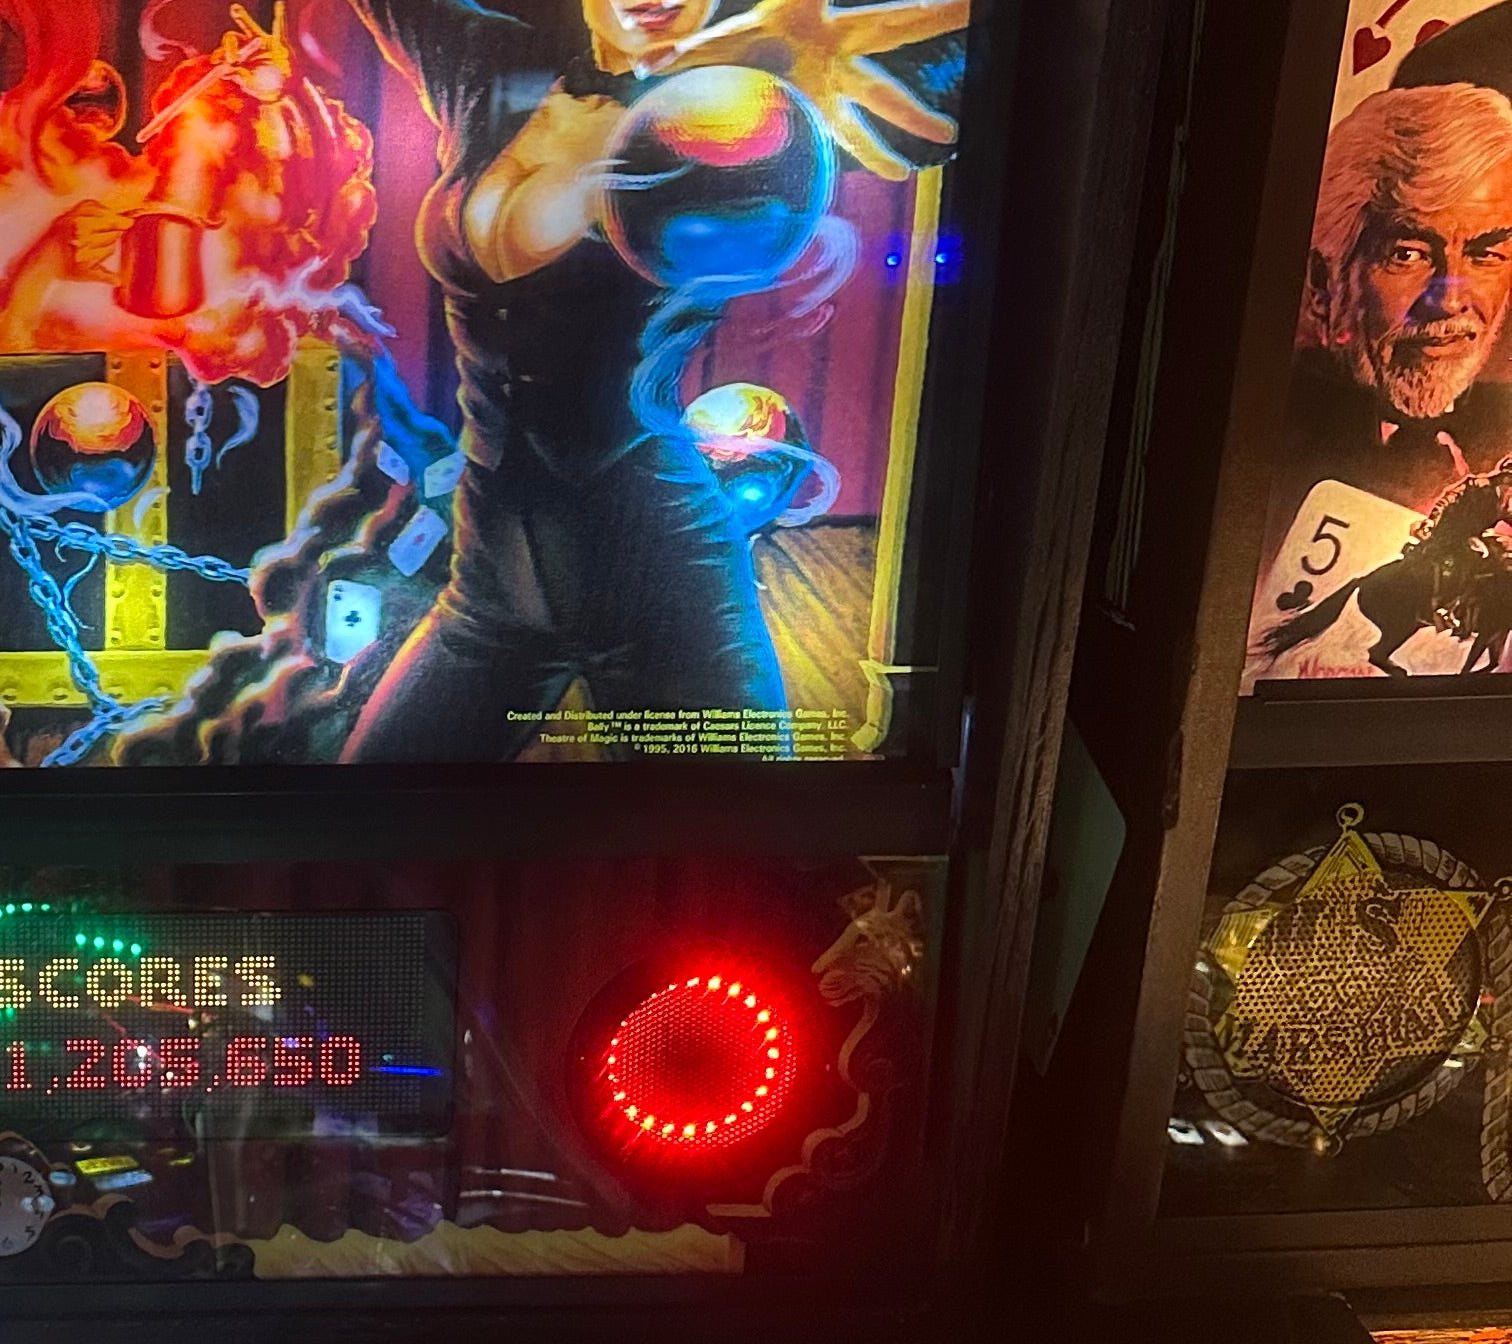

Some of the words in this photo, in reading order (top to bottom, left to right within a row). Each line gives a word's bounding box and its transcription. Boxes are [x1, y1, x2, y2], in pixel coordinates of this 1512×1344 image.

[1301, 514, 1351, 576] 5
[507, 711, 542, 721] Created
[545, 711, 562, 720] and
[564, 710, 614, 720] Distributed
[616, 710, 642, 720] under
[679, 710, 700, 719] from
[702, 709, 741, 719] Williams
[743, 709, 792, 719] Electronics
[588, 722, 609, 733] Bally
[624, 722, 632, 731] is
[643, 722, 688, 731] trademark
[691, 722, 701, 731] of
[540, 733, 575, 743] Theatre
[577, 733, 588, 743] of
[590, 733, 618, 744] Magic
[620, 733, 629, 743] is
[631, 733, 682, 743] trademarks
[685, 733, 695, 742] of
[698, 733, 737, 742] Williams
[739, 733, 790, 742] Electronics
[643, 744, 671, 754] 1995,
[673, 744, 698, 754] 2016
[700, 744, 738, 754] Williams
[740, 744, 791, 753] Electronics
[830, 743, 847, 753] Inc.
[23, 1171, 35, 1184] 2
[25, 1225, 36, 1242] 5
